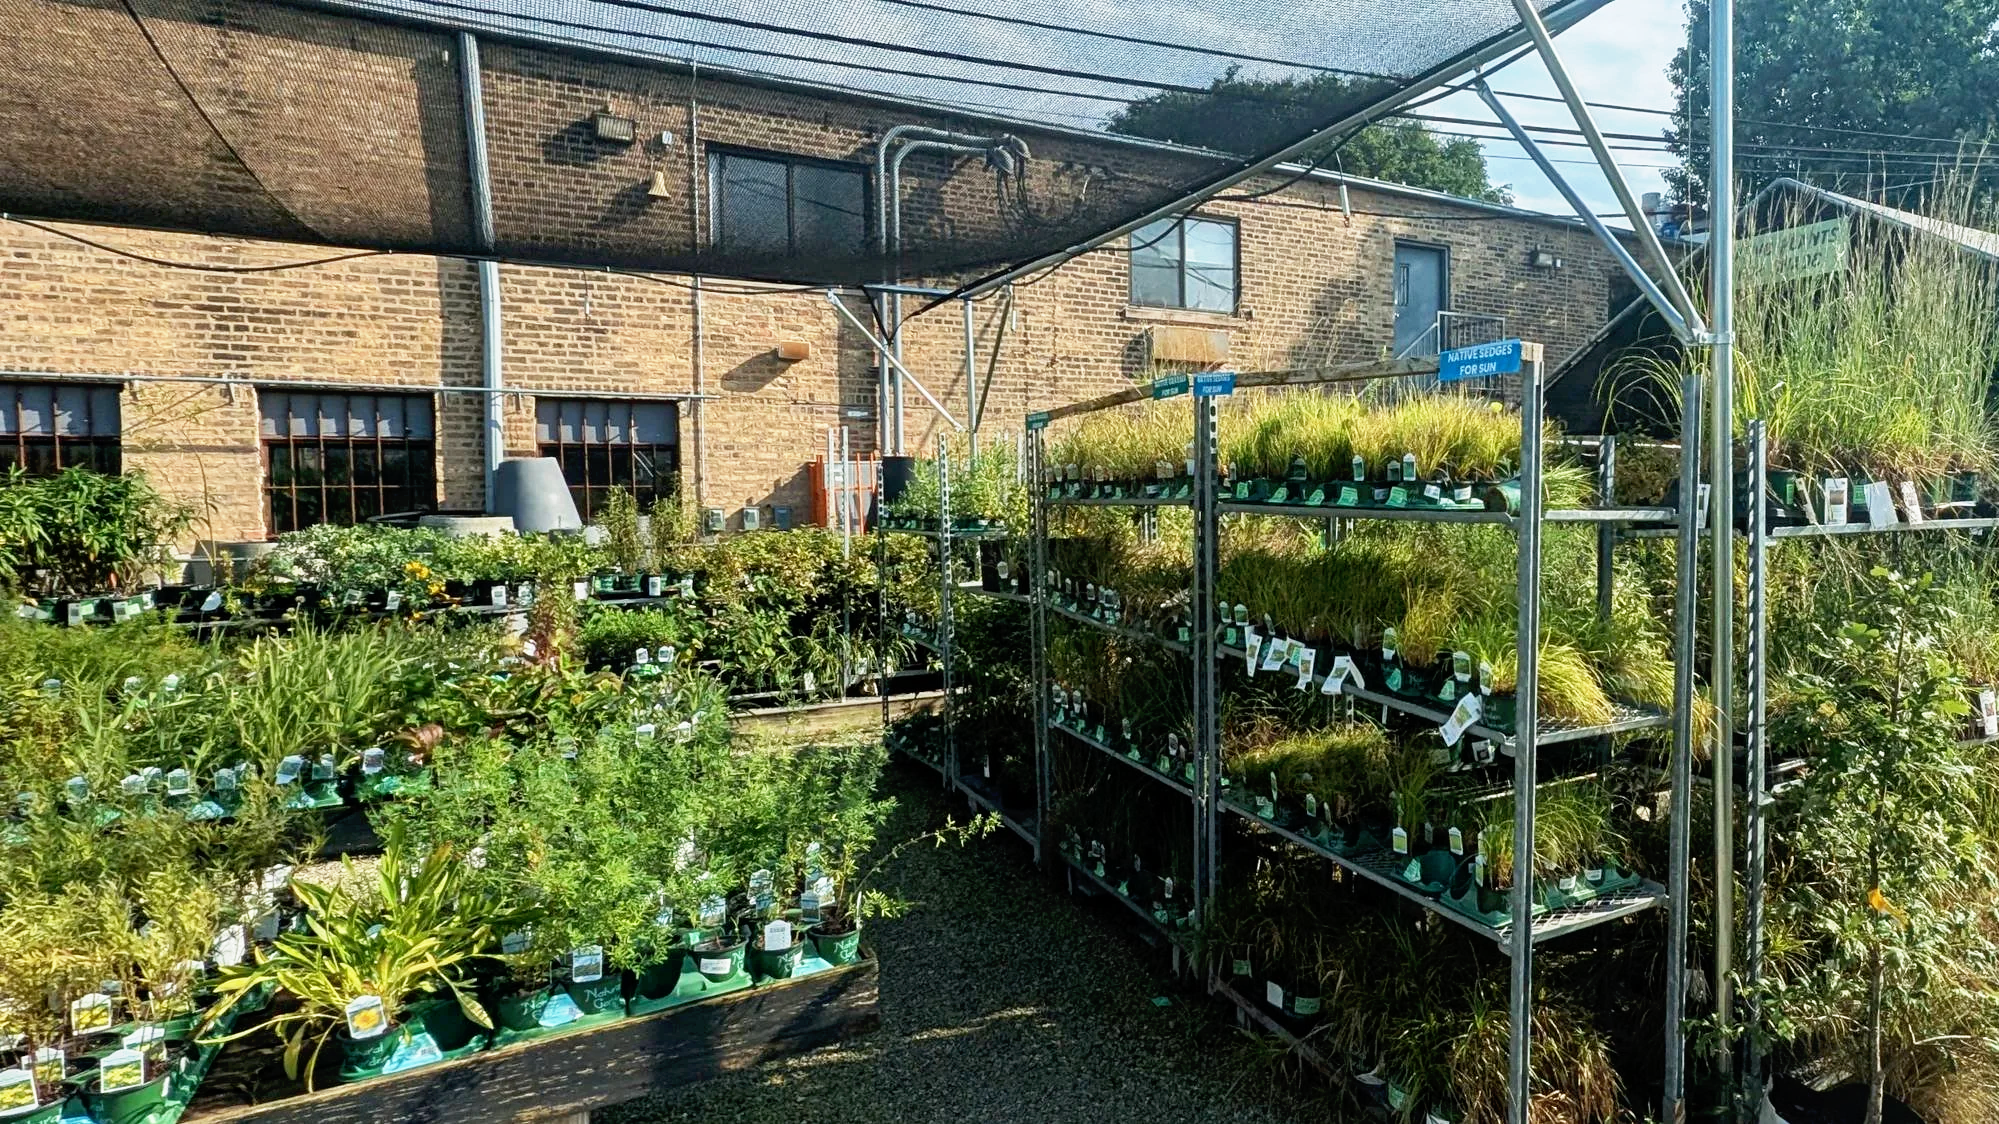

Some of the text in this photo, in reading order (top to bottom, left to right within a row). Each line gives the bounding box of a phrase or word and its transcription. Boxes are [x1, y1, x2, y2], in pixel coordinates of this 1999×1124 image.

[1448, 344, 1512, 363] NATIVE SEDGES
[1459, 361, 1497, 376] FOR SUN
